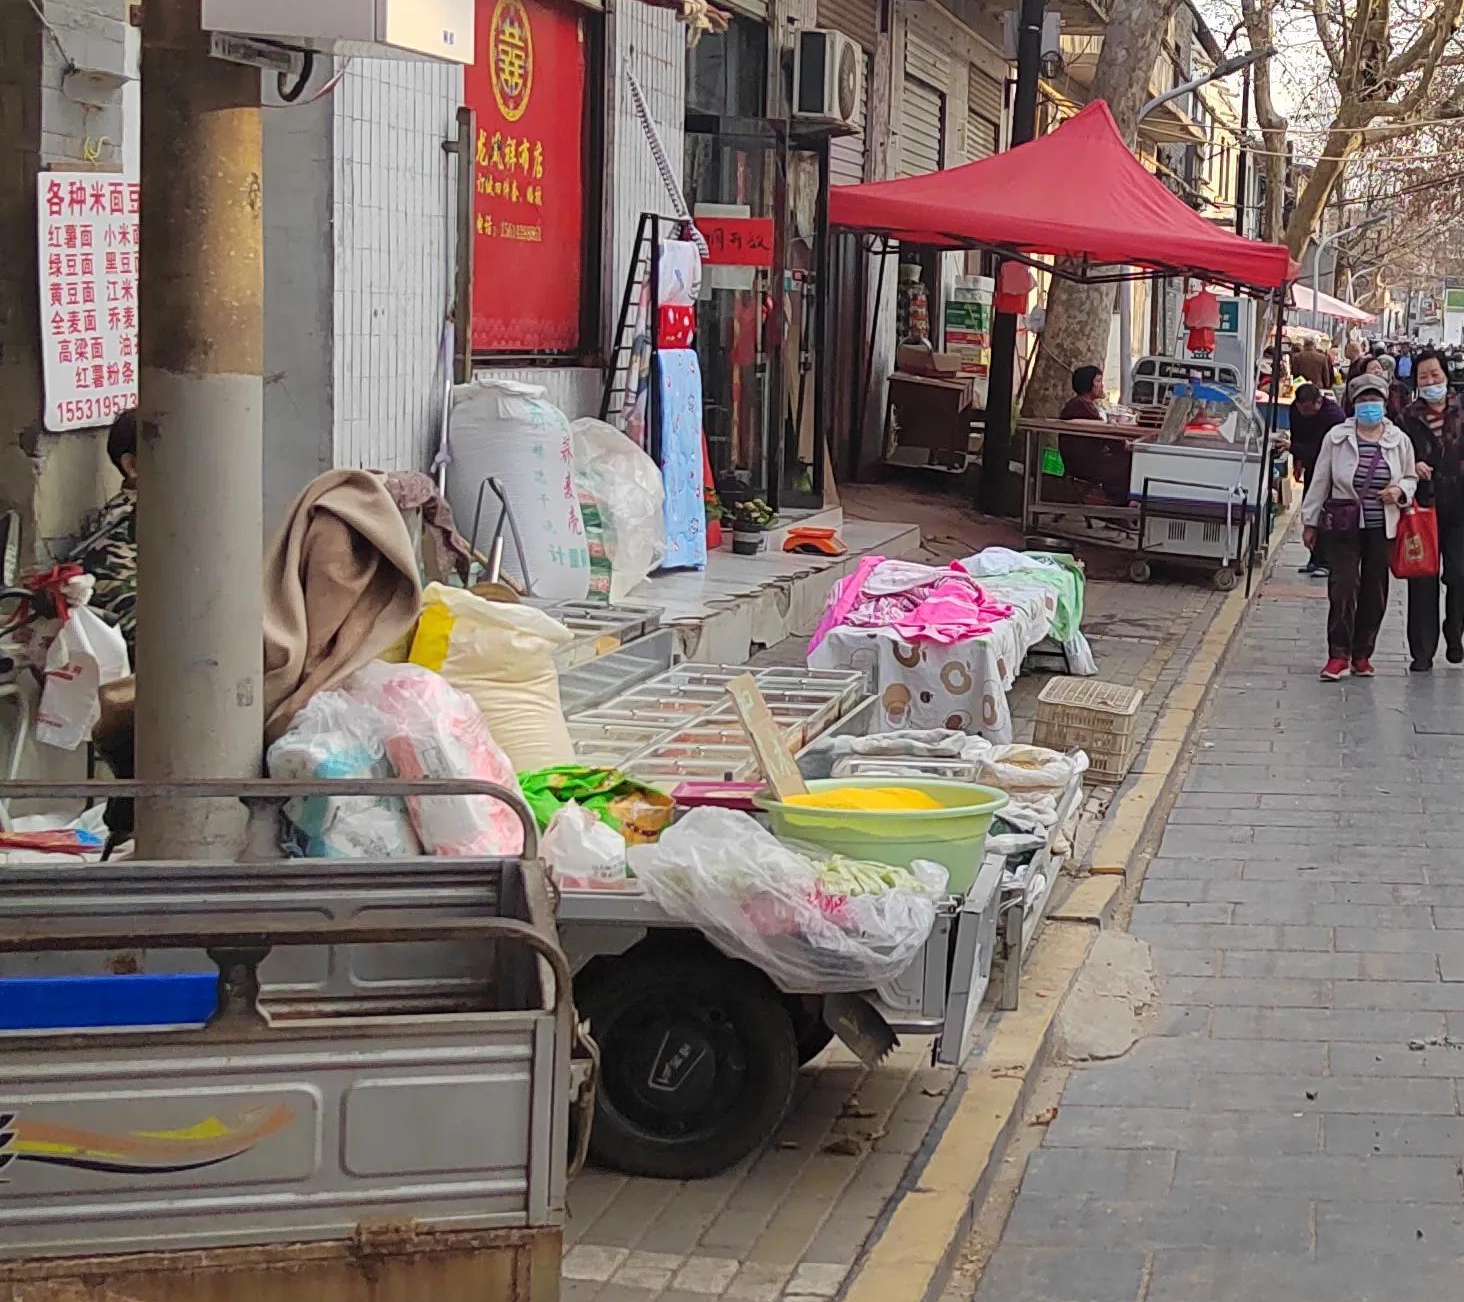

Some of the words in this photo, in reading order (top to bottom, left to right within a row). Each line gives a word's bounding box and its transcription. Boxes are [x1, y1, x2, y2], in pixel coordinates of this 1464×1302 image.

[48, 253, 94, 277] 绿豆面
[49, 281, 95, 306] 黄豆面
[50, 309, 97, 335] 全麦面
[119, 333, 140, 357] 油
